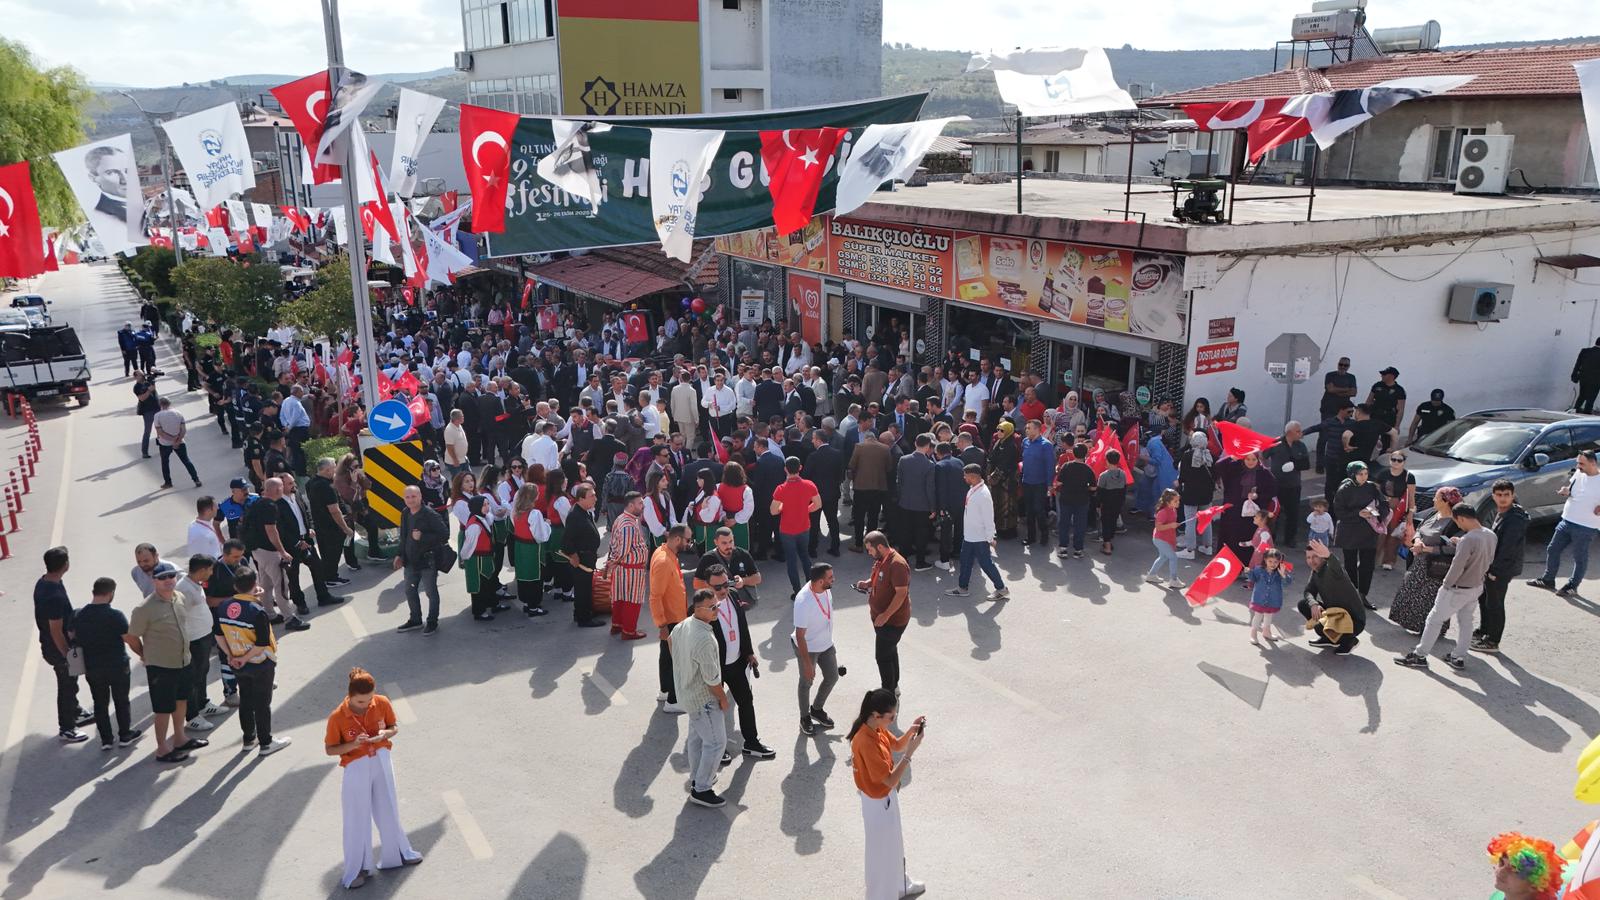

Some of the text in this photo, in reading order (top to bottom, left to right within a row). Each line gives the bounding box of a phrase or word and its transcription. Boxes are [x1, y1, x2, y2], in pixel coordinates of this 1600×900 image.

[623, 82, 686, 98] HAMZA
[594, 91, 607, 106] H
[831, 221, 951, 252] BALIKÇIOĞLU
[843, 241, 940, 263] SÜPER MARKET
[912, 263, 925, 272] 73
[929, 266, 943, 275] 52
[891, 269, 910, 279] 442
[913, 272, 926, 281] 50
[929, 275, 943, 285] 01
[894, 278, 911, 287] 311
[914, 282, 926, 290] 25
[929, 285, 942, 293] 96
[1198, 349, 1221, 361] DOSTLAR
